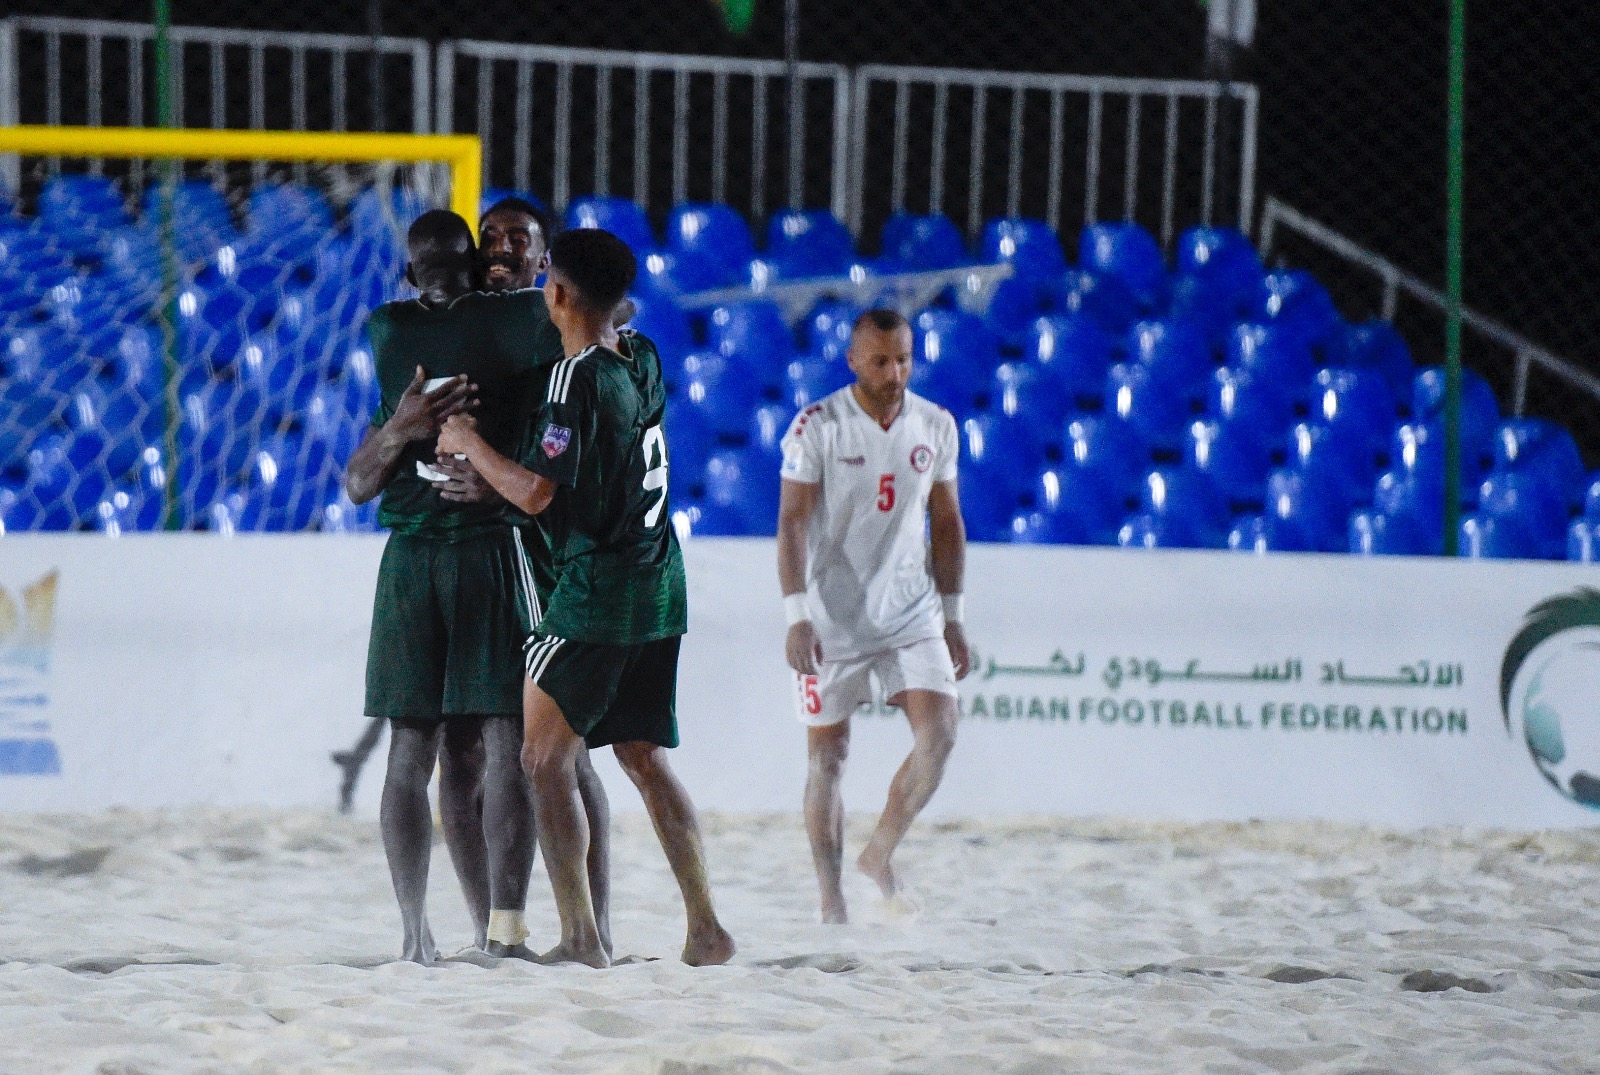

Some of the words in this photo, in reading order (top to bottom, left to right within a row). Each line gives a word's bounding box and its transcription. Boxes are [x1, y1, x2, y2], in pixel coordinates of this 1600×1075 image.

[642, 425, 668, 526] 9
[877, 473, 895, 512] 5
[806, 676, 822, 714] 5
[959, 694, 1071, 720] ABIAN
[1079, 698, 1251, 728] FOOTBALL
[1260, 703, 1468, 734] FEDERATION
